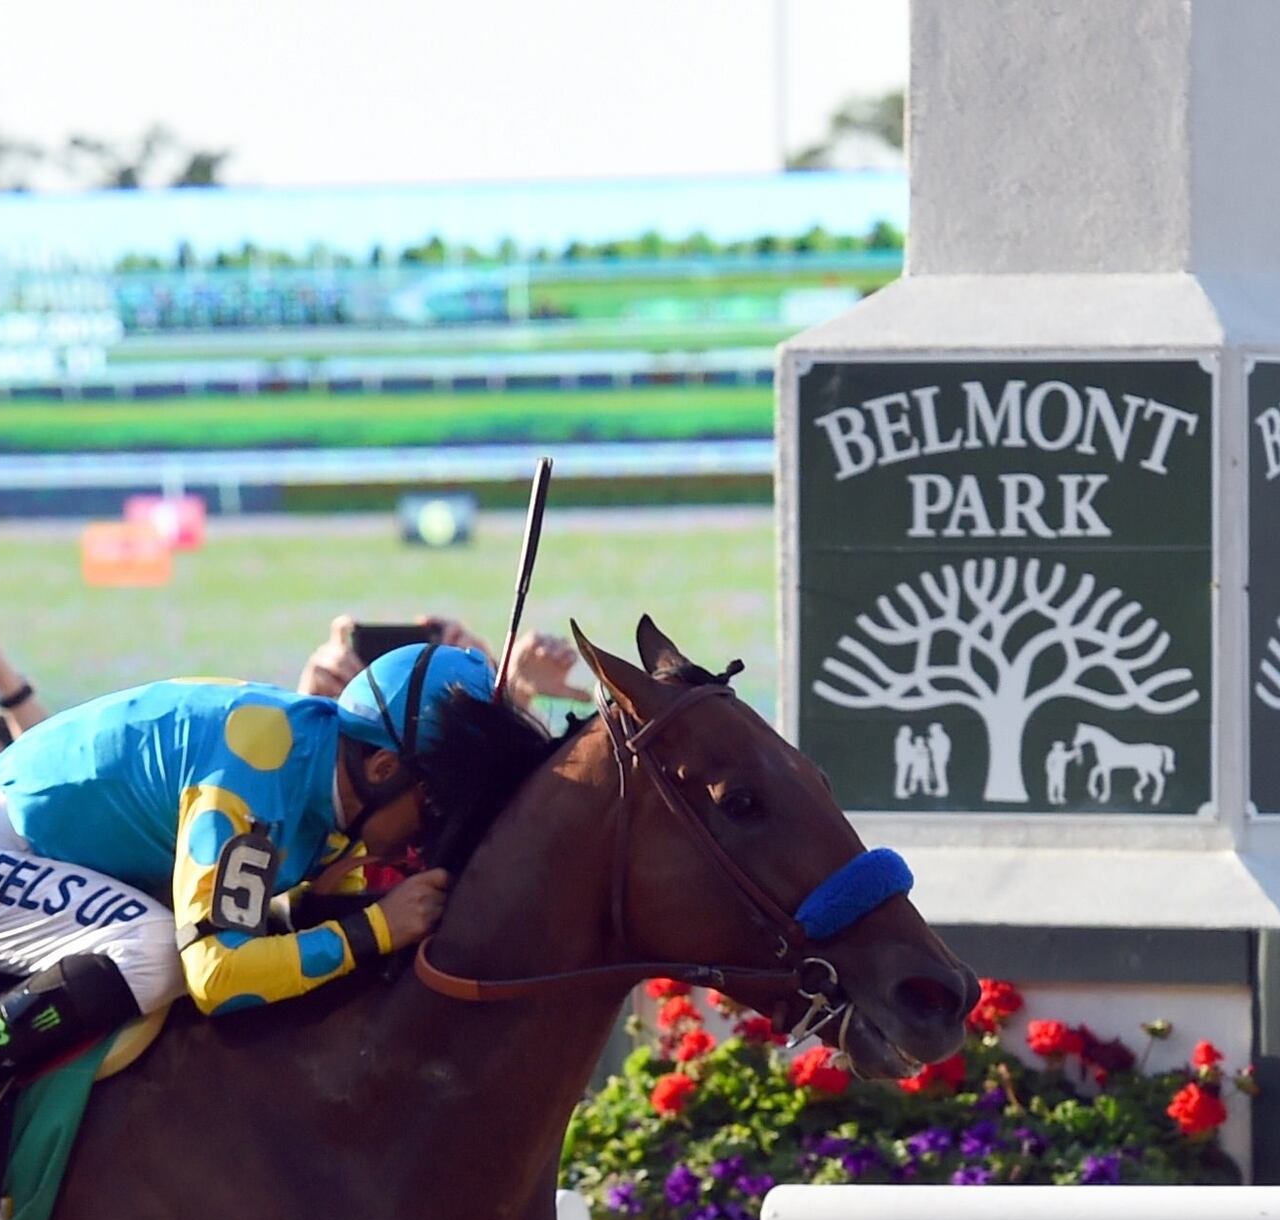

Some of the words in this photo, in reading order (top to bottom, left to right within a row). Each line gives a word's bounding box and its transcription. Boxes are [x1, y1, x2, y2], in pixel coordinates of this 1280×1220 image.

[814, 379, 1198, 481] BELMONT
[906, 473, 1112, 538] PARK
[221, 846, 270, 929] 5
